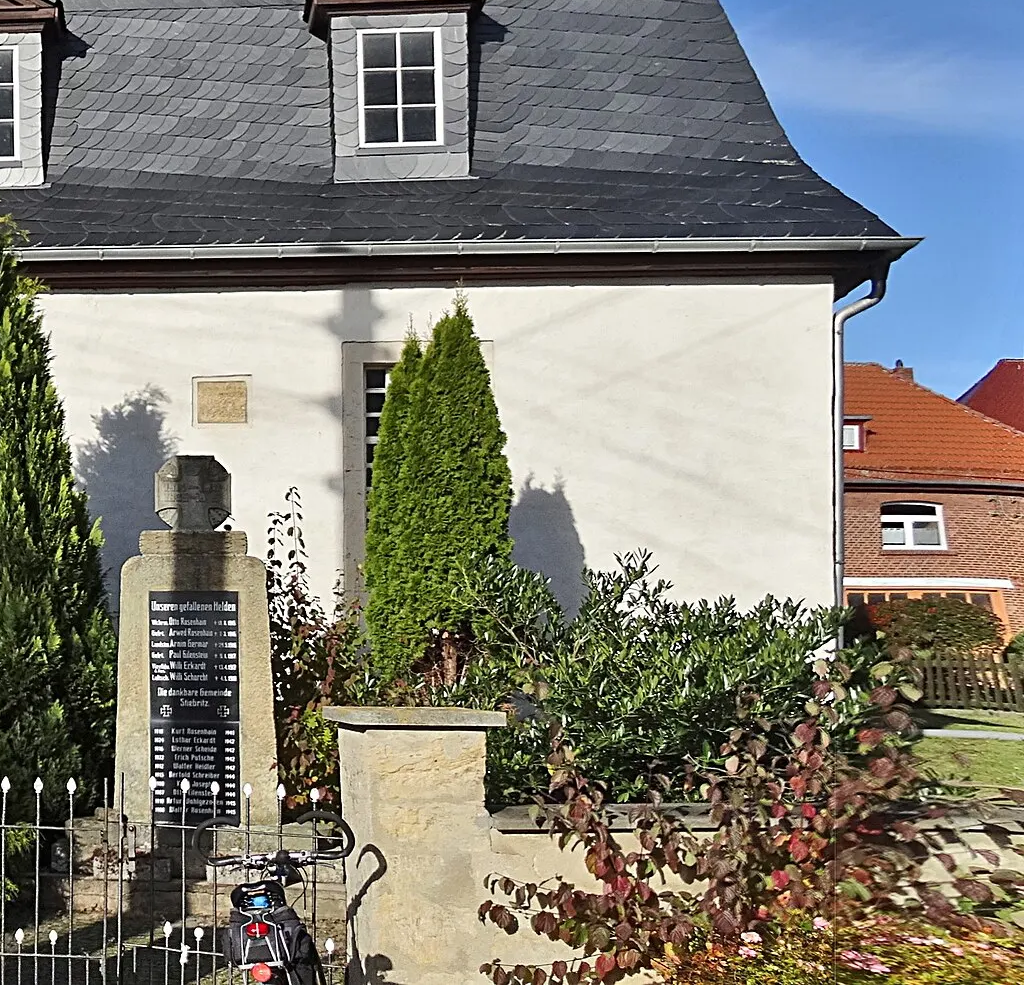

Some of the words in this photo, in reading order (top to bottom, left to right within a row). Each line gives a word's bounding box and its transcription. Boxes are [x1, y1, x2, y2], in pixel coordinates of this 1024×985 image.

[151, 601, 178, 611] Unseren
[179, 602, 212, 612] gefallenen
[214, 601, 236, 611] Helden
[169, 650, 181, 658] Paul
[157, 687, 168, 696] Die
[168, 687, 198, 696] dankbare
[200, 688, 232, 696] Gemeinde
